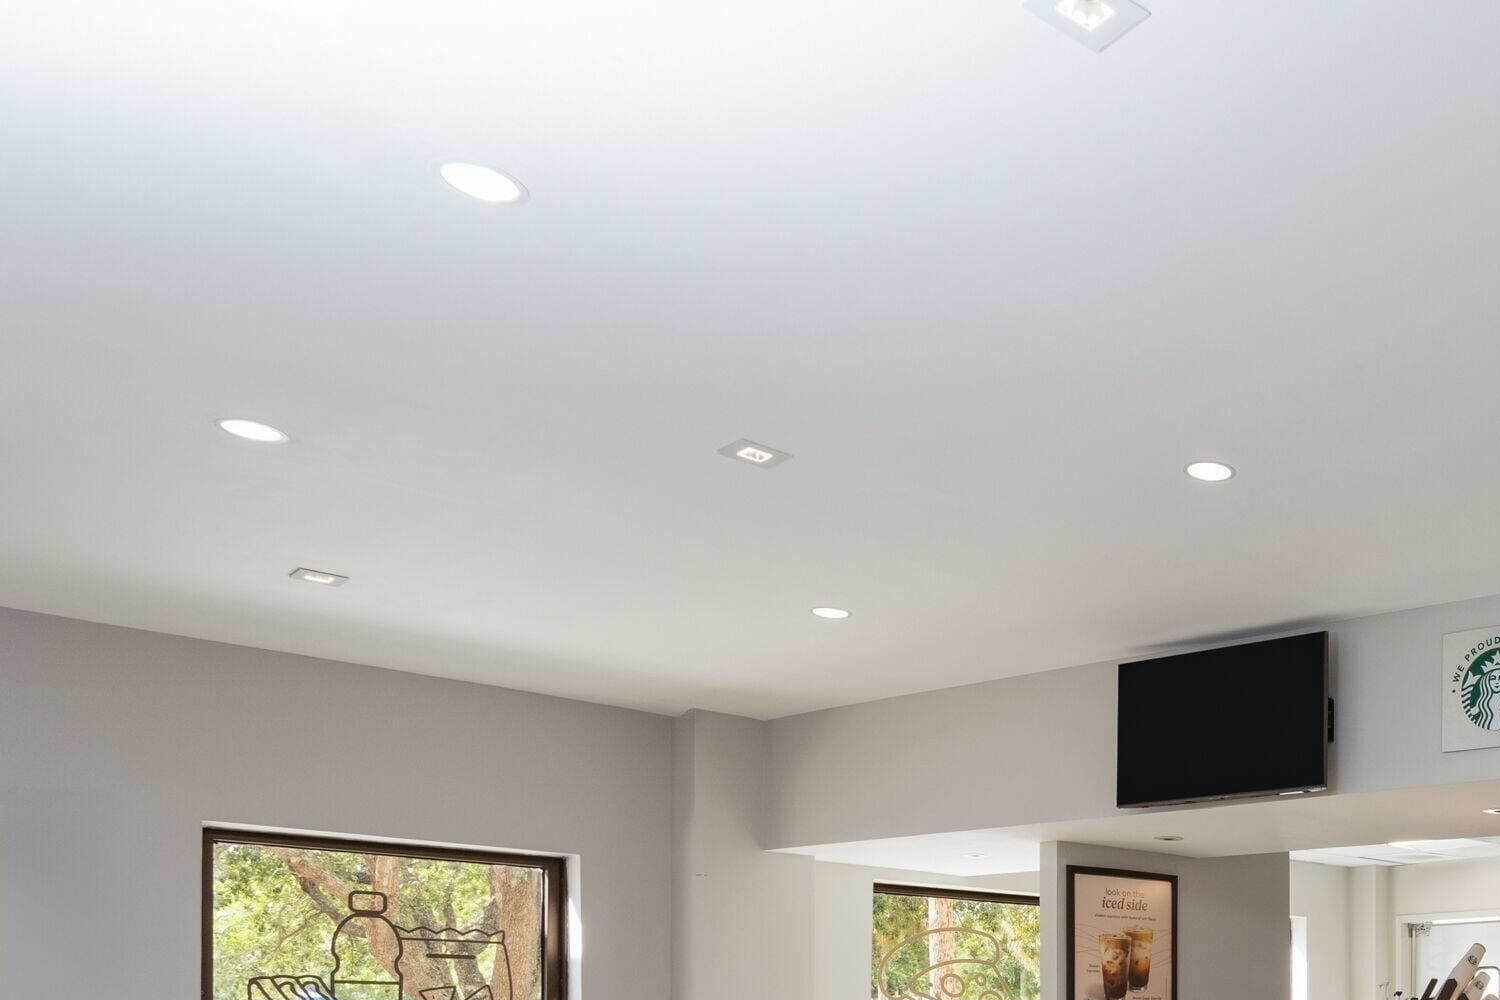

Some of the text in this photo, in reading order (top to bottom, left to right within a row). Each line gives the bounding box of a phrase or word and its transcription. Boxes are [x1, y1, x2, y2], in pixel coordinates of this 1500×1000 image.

[1452, 664, 1465, 683] WE
[1105, 888, 1121, 897] look
[1102, 897, 1148, 911] iced side
